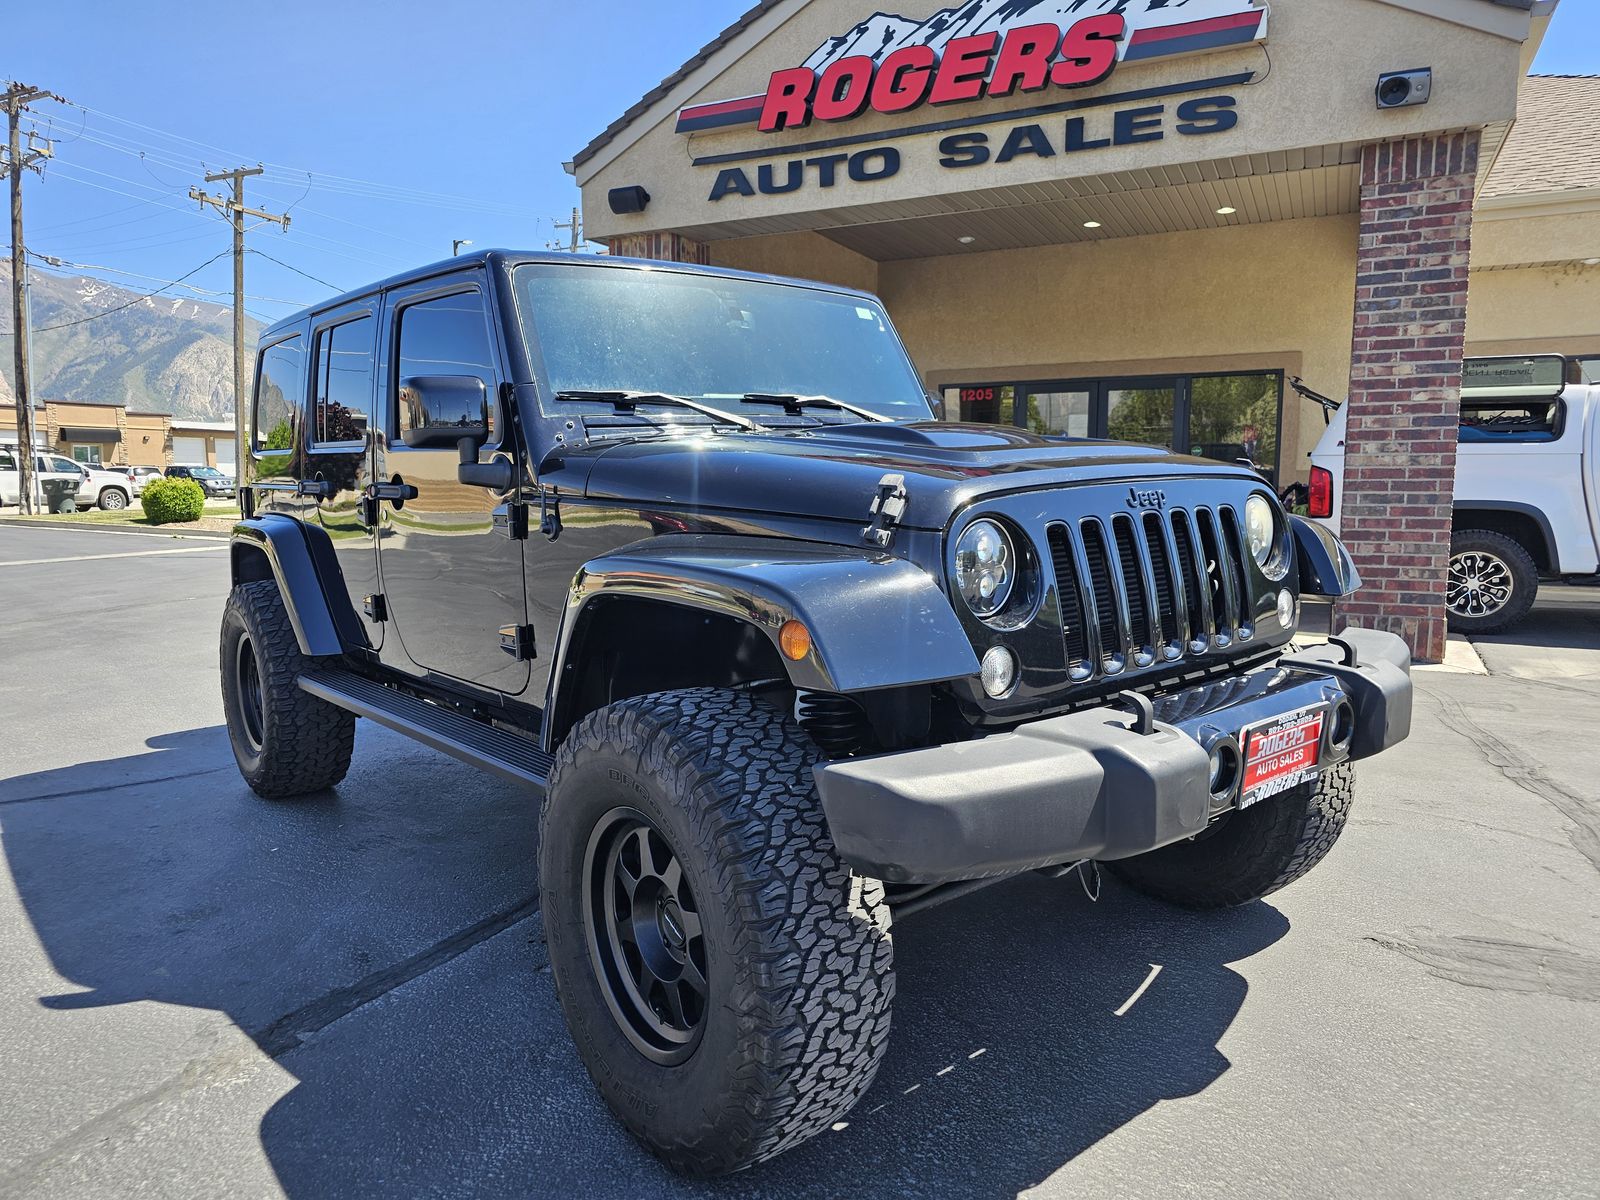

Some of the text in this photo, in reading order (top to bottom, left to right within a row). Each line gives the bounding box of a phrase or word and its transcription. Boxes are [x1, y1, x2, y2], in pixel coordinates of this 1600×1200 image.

[757, 13, 1128, 134] ROGERS
[708, 95, 1239, 202] AUTO SALES
[961, 388, 993, 401] 1205
[1125, 486, 1166, 509] Jeep
[1257, 727, 1305, 759] ROGERS
[1256, 760, 1279, 777] AUTO
[1279, 749, 1304, 768] SALES
[1256, 771, 1301, 802] ROGERS
